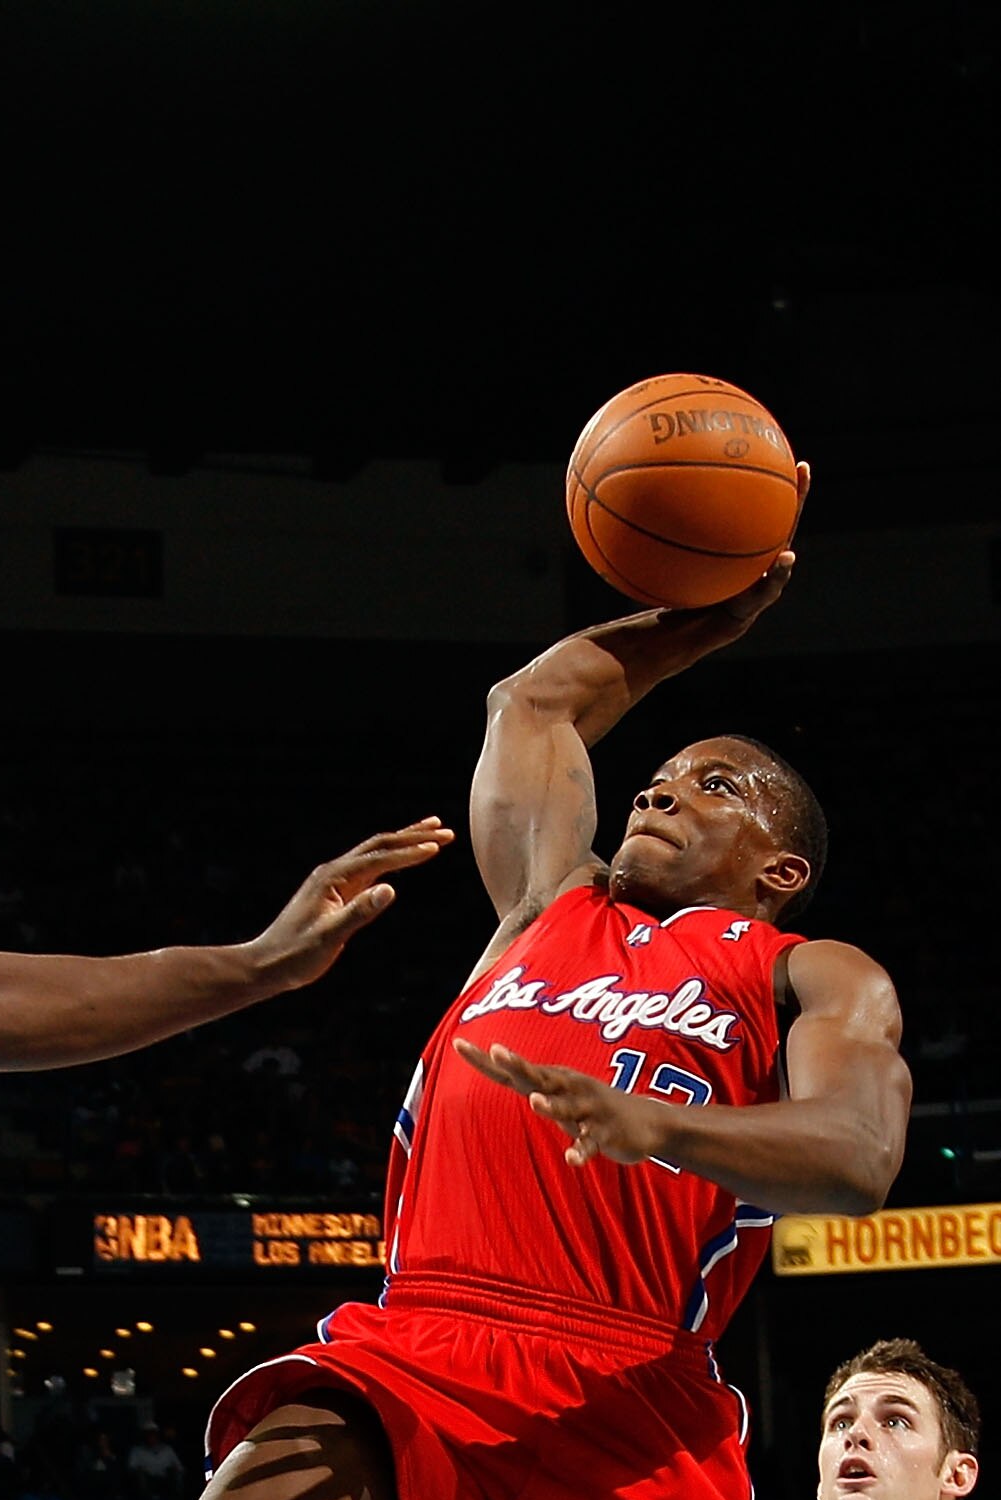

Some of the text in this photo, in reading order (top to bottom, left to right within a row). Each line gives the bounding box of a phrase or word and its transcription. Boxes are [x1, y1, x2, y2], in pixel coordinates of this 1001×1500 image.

[460, 964, 740, 1051] Los Angeles
[254, 1241, 301, 1266] LOS
